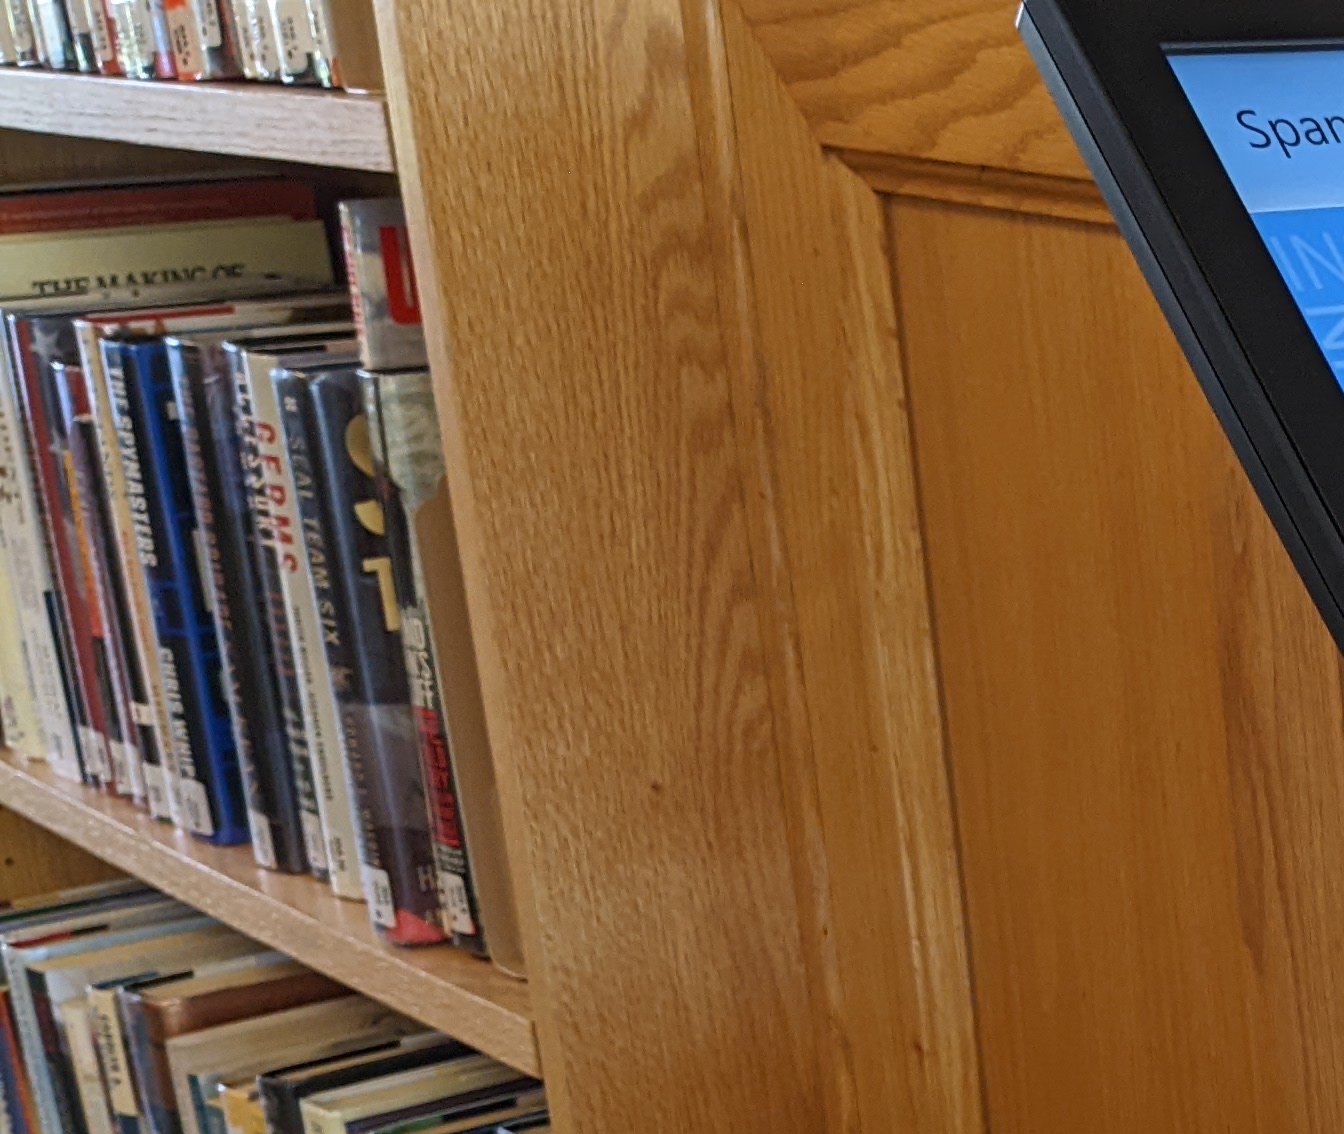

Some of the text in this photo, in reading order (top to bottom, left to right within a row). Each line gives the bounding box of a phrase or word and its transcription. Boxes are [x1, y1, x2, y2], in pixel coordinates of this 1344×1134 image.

[120, 413, 158, 567] SPYMASTERS
[301, 516, 331, 588] TEAM
[316, 599, 342, 646] SIX
